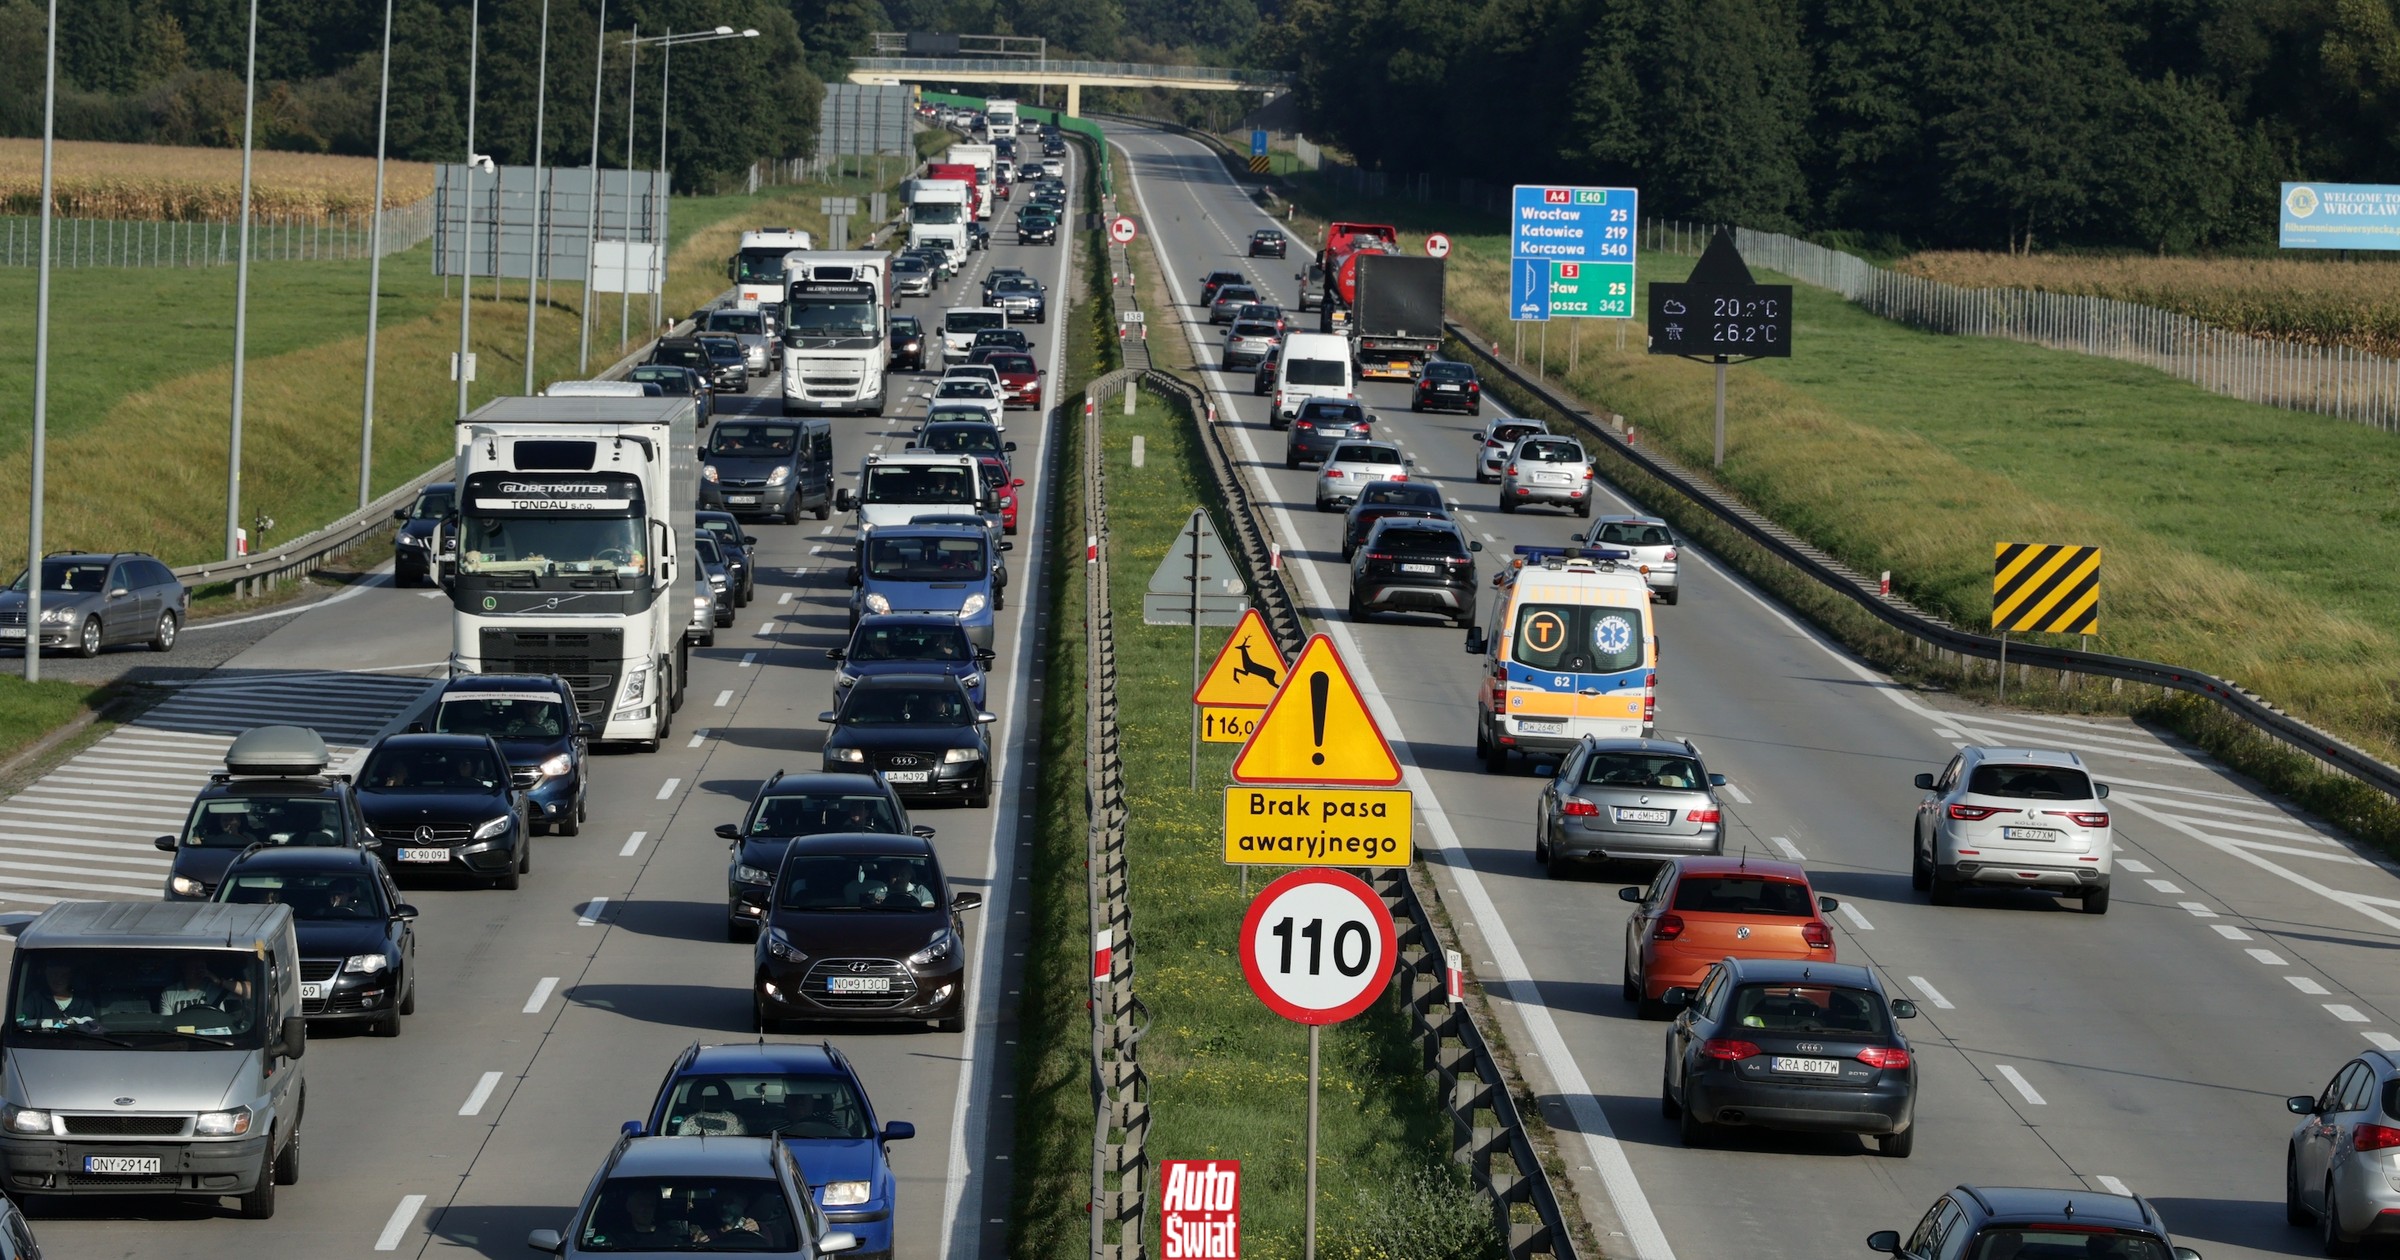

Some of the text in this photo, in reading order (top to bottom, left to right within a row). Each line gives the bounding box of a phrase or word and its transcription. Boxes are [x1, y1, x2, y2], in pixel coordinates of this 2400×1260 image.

[1550, 192, 1565, 202] A4
[1580, 193, 1600, 202] E40
[2324, 192, 2400, 203] WELCOME TO
[1521, 207, 1627, 221] Wrocław 25
[2324, 203, 2399, 216] WROCŁAW
[1521, 224, 1628, 239] Katowice 219
[1520, 241, 1627, 256] Korczowa 540
[1566, 266, 1574, 276] 5
[1609, 283, 1626, 295] 25
[1550, 300, 1625, 312] oszcz 342
[1126, 313, 1142, 321] 138
[503, 484, 608, 493] GLOBETROTTER
[511, 500, 595, 510] TONDAU s.r.o.
[486, 598, 493, 607] L
[1536, 622, 1553, 643] T
[1554, 676, 1570, 687] 62
[1220, 717, 1259, 737] 16,0
[1537, 724, 1561, 732] 264KS
[1250, 793, 1387, 823] Brak pasa
[1623, 811, 1634, 819] DW
[2026, 831, 2053, 840] 677XM
[1239, 830, 1397, 859] awaryjnego
[405, 851, 446, 859] DC 90 091
[1272, 916, 1372, 978] 110
[302, 986, 315, 996] 69
[1778, 1059, 1838, 1073] KRA 8017W
[93, 1159, 157, 1172] ONY 29141
